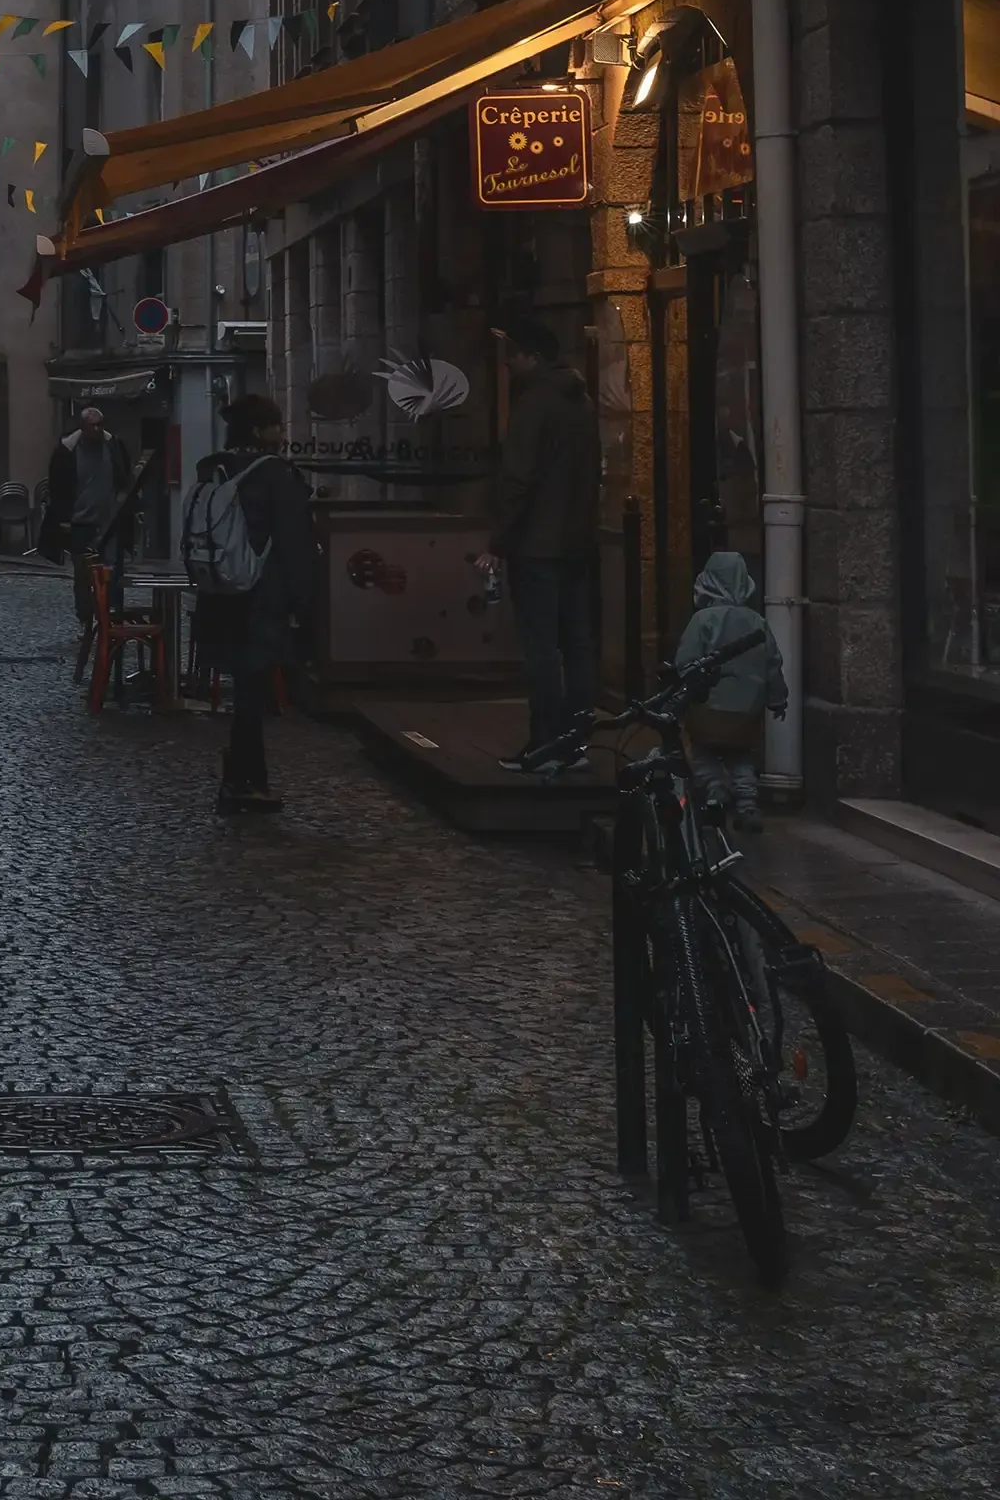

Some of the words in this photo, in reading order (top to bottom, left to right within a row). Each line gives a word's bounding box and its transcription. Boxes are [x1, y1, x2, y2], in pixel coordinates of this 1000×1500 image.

[481, 104, 581, 129] Crêperie
[484, 153, 581, 195] Tournesol
[506, 155, 529, 174] Le
